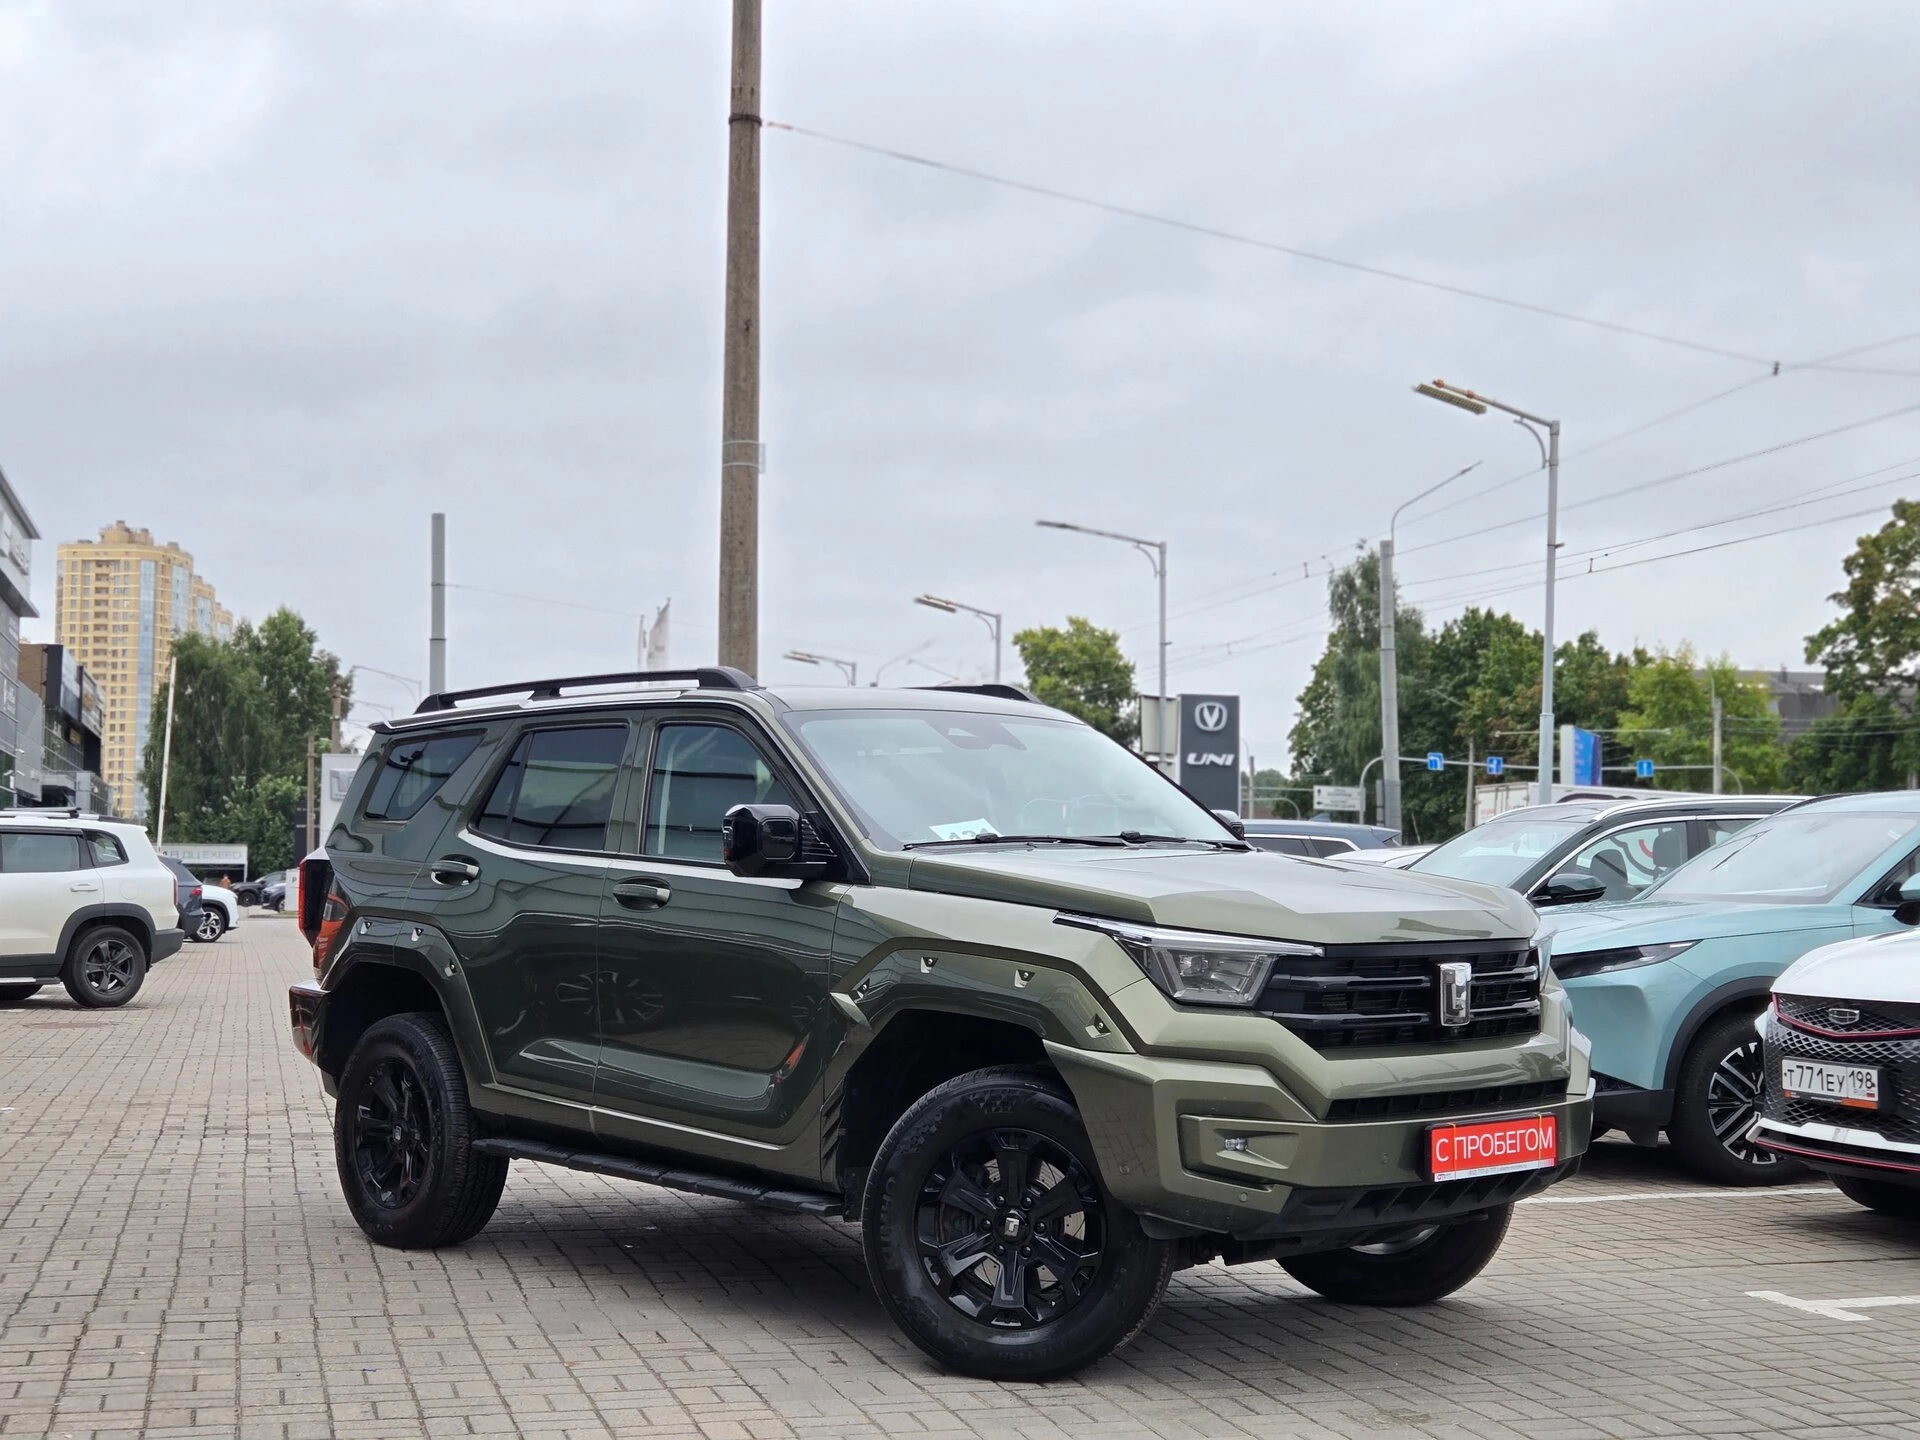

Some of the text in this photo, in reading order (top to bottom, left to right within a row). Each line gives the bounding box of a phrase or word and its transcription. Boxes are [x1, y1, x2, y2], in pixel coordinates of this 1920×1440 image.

[1186, 753, 1235, 766] UNI
[1849, 1070, 1874, 1089] 198
[1435, 1126, 1553, 1162] С ПРОБЕГОМ
